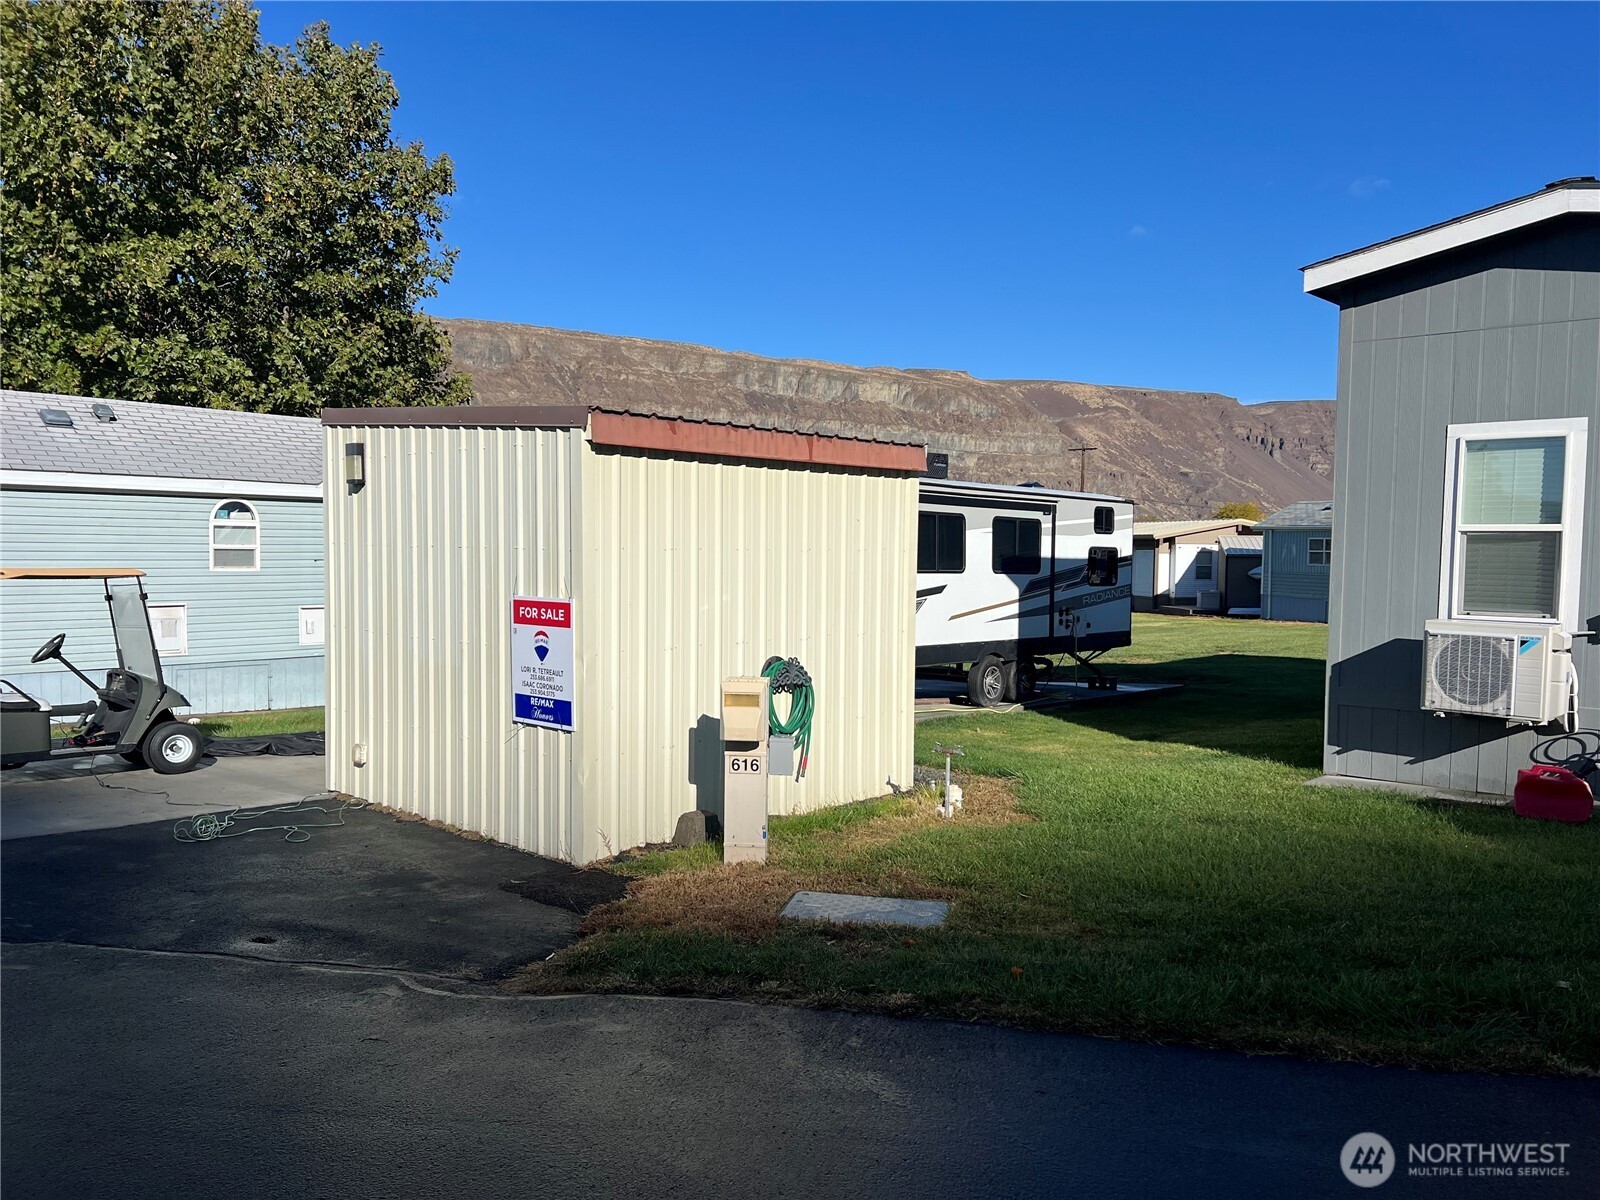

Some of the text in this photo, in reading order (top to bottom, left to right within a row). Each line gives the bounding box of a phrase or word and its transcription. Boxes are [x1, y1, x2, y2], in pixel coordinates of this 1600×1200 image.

[1082, 586, 1130, 605] RADIANCE
[519, 606, 565, 621] FOR SALE
[521, 665, 531, 673] LORI
[538, 667, 564, 677] TETREAULT
[522, 680, 564, 692] ISAAC CORONADO
[530, 697, 554, 708] RE/MAX
[731, 758, 760, 772] 616
